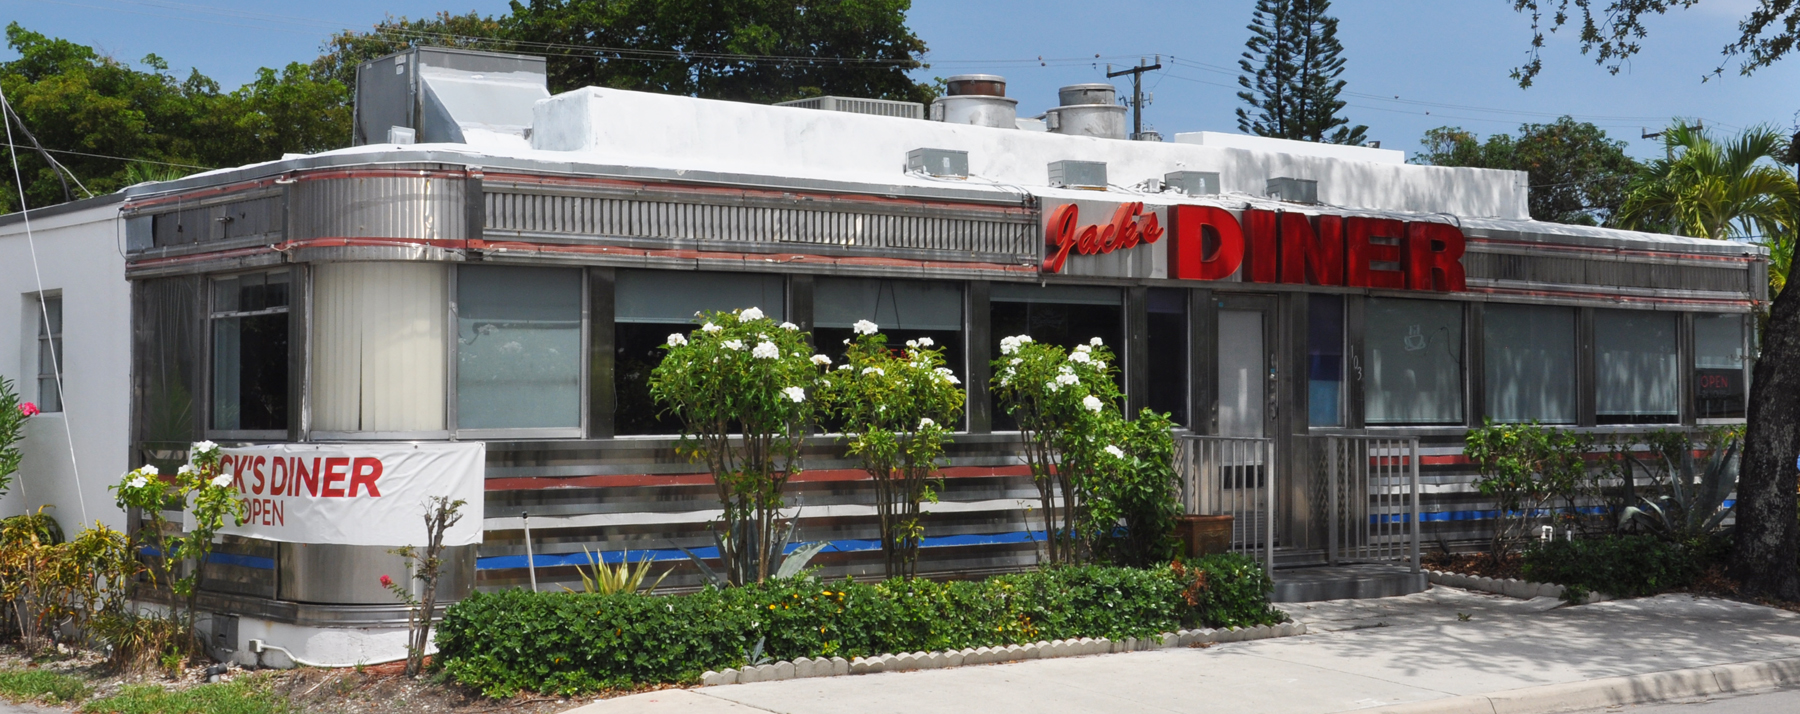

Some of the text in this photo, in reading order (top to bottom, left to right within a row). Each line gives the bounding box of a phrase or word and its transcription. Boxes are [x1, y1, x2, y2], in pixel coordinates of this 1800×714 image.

[1042, 201, 1467, 292] Jack's DINER
[1351, 344, 1363, 380] 103
[1700, 375, 1729, 388] OPEN
[192, 454, 384, 498] CK'S DINER
[241, 497, 284, 527] OPEN
